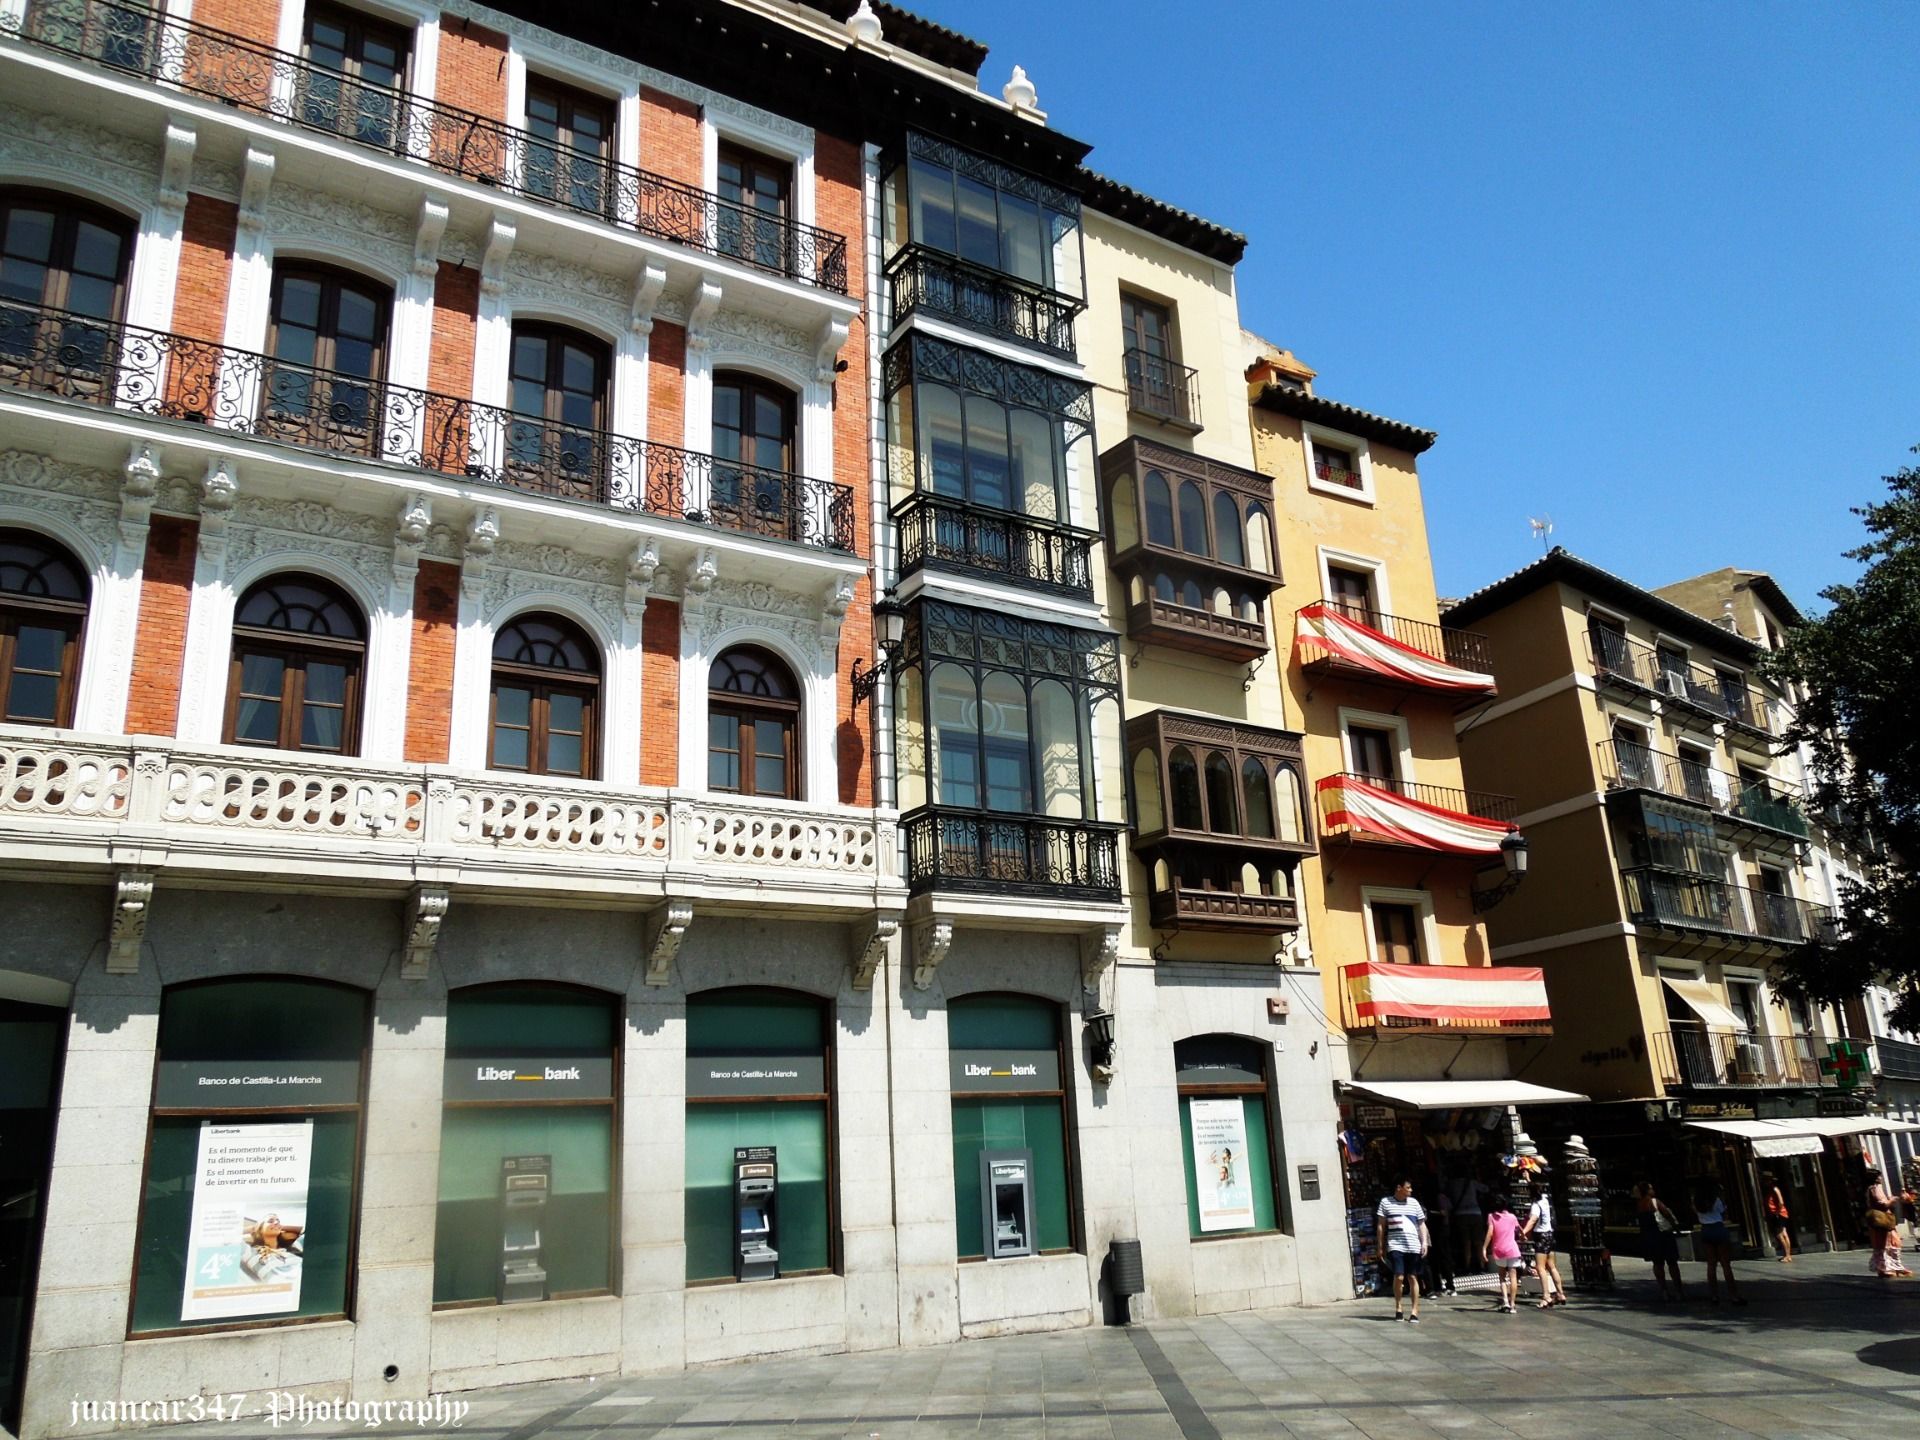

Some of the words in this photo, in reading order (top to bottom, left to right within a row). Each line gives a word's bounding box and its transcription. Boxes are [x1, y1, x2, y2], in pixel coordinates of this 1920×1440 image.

[710, 1071, 731, 1079] Banco
[773, 1070, 798, 1078] Mancha
[198, 1077, 228, 1086] Banco
[228, 1077, 241, 1085] de
[242, 1076, 287, 1085] Castilla-La
[288, 1076, 322, 1084] Mancha
[278, 1146, 293, 1154] que
[246, 1155, 272, 1164] trabaje
[274, 1155, 288, 1163] por
[217, 1178, 247, 1186] invertir
[270, 1176, 297, 1184] futuro.
